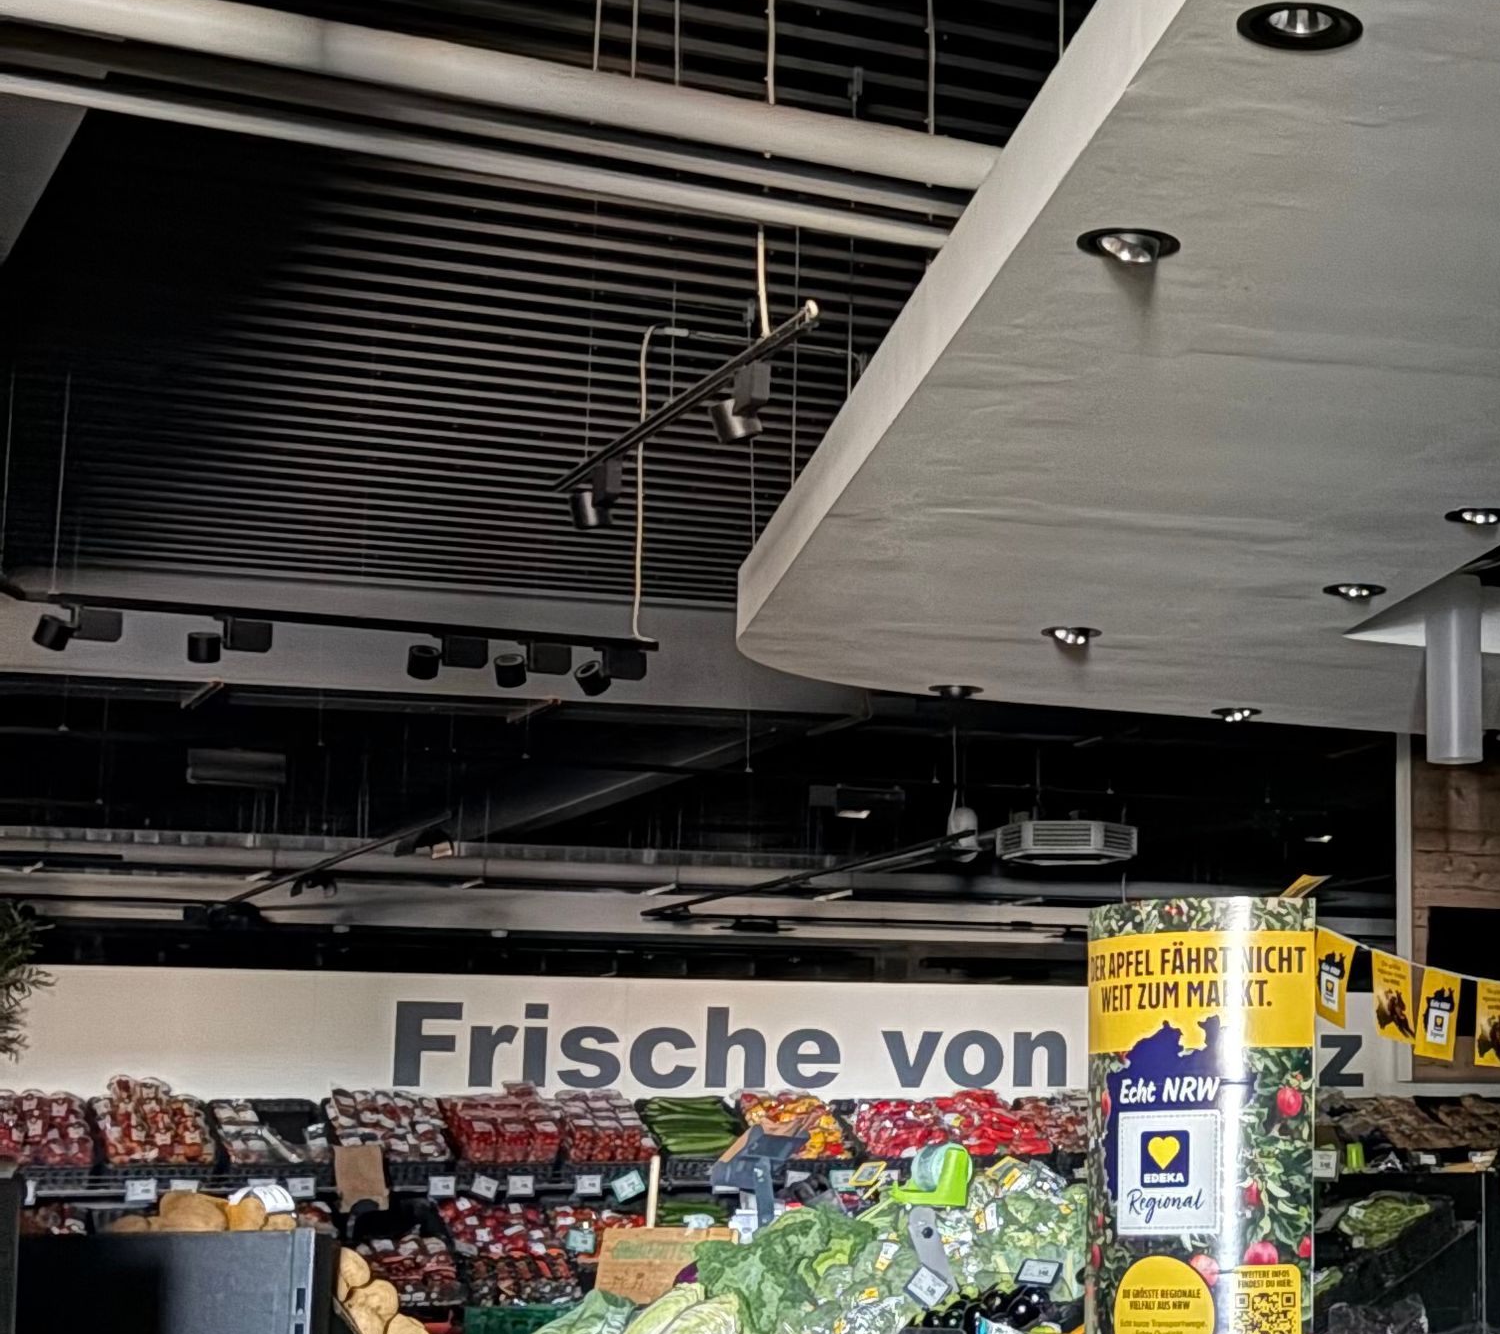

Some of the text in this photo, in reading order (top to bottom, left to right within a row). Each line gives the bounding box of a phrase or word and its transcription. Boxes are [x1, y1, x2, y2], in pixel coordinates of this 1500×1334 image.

[1108, 950, 1154, 980] APFEL
[1160, 941, 1232, 976] FÄHRT
[1241, 946, 1307, 974] NICHT
[1101, 979, 1273, 1013] WEIT ZUM MAKT.
[392, 1000, 842, 1089] Frische
[881, 1027, 1067, 1089] von
[1119, 1076, 1221, 1104] Echt NRW
[1143, 1172, 1185, 1184] EDEKA
[1127, 1188, 1206, 1224] Regional
[1129, 1300, 1191, 1311] VIELFALT AUS NRW
[1160, 1288, 1201, 1299] REGIONALE
